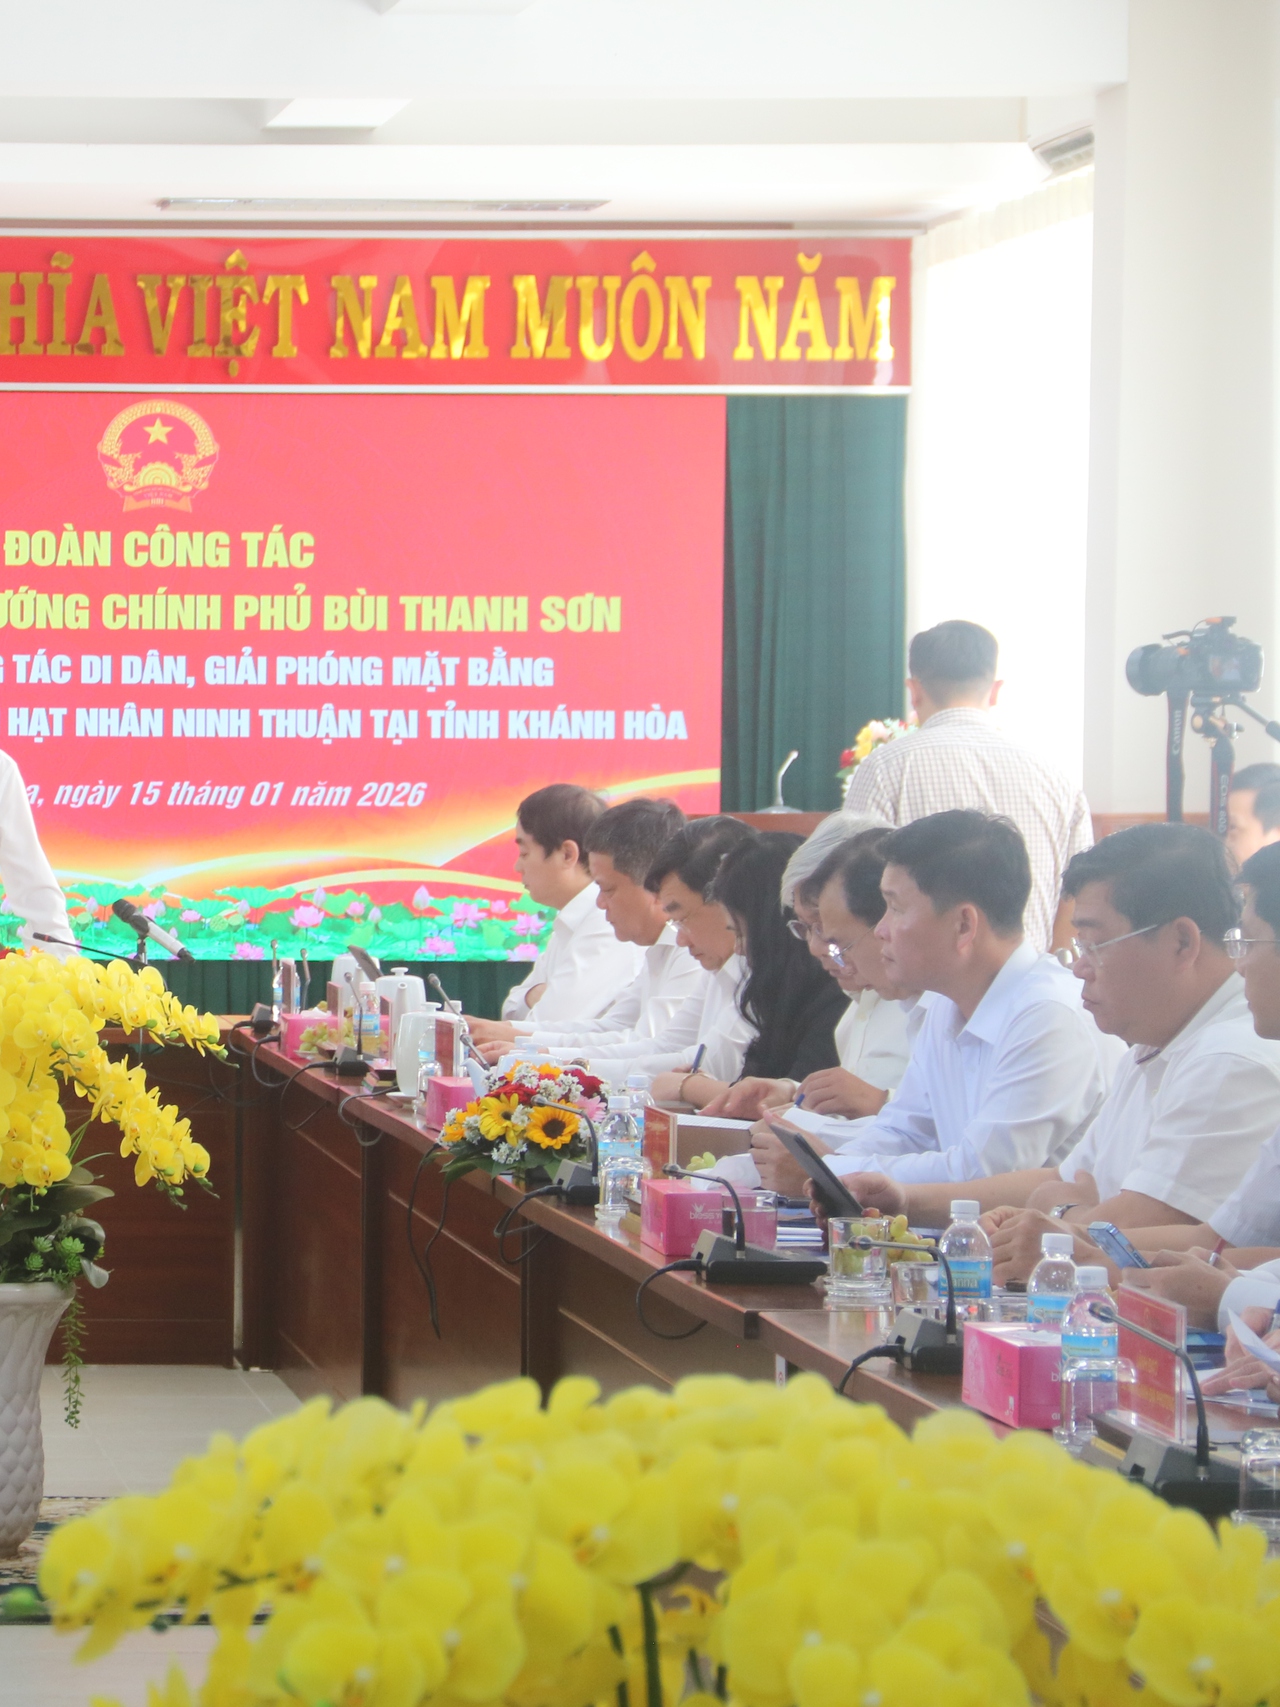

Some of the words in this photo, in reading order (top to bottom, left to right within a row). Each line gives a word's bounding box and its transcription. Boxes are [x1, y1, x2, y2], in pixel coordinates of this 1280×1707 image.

[137, 249, 309, 378] VIỆT
[329, 274, 491, 360] NAM
[511, 250, 712, 362] MUÔN
[733, 252, 897, 362] NĂM
[3, 523, 112, 567] ĐOÀN
[123, 523, 231, 568] CÔNG
[241, 524, 315, 568] TÁC
[101, 587, 222, 631] CHÍNH
[233, 583, 312, 632] PHỦ
[322, 588, 389, 632] BÙI
[399, 596, 529, 632] THANH
[540, 592, 622, 633] SƠN
[12, 648, 71, 685] TÁC
[81, 654, 110, 685] DI
[121, 649, 196, 688] DÂN,
[204, 646, 267, 686] GIẢI
[276, 650, 383, 687] PHÓNG
[392, 651, 460, 692] MẶT
[468, 646, 555, 688] BẰNG
[8, 707, 66, 743] HẠT
[76, 702, 164, 738] NHÂN
[172, 708, 250, 738] NINH
[258, 703, 362, 745] THUẬN
[370, 708, 419, 745] TẠI
[426, 700, 500, 739] TỈNH
[508, 704, 616, 740] KHÁNH
[623, 703, 688, 740] HÒA
[1171, 709, 1182, 755] Canon
[54, 780, 122, 808] ngày
[130, 781, 163, 806] 15
[168, 781, 245, 809] tháng
[251, 781, 285, 807] 01
[291, 781, 351, 807] năm
[356, 781, 427, 808] 2026
